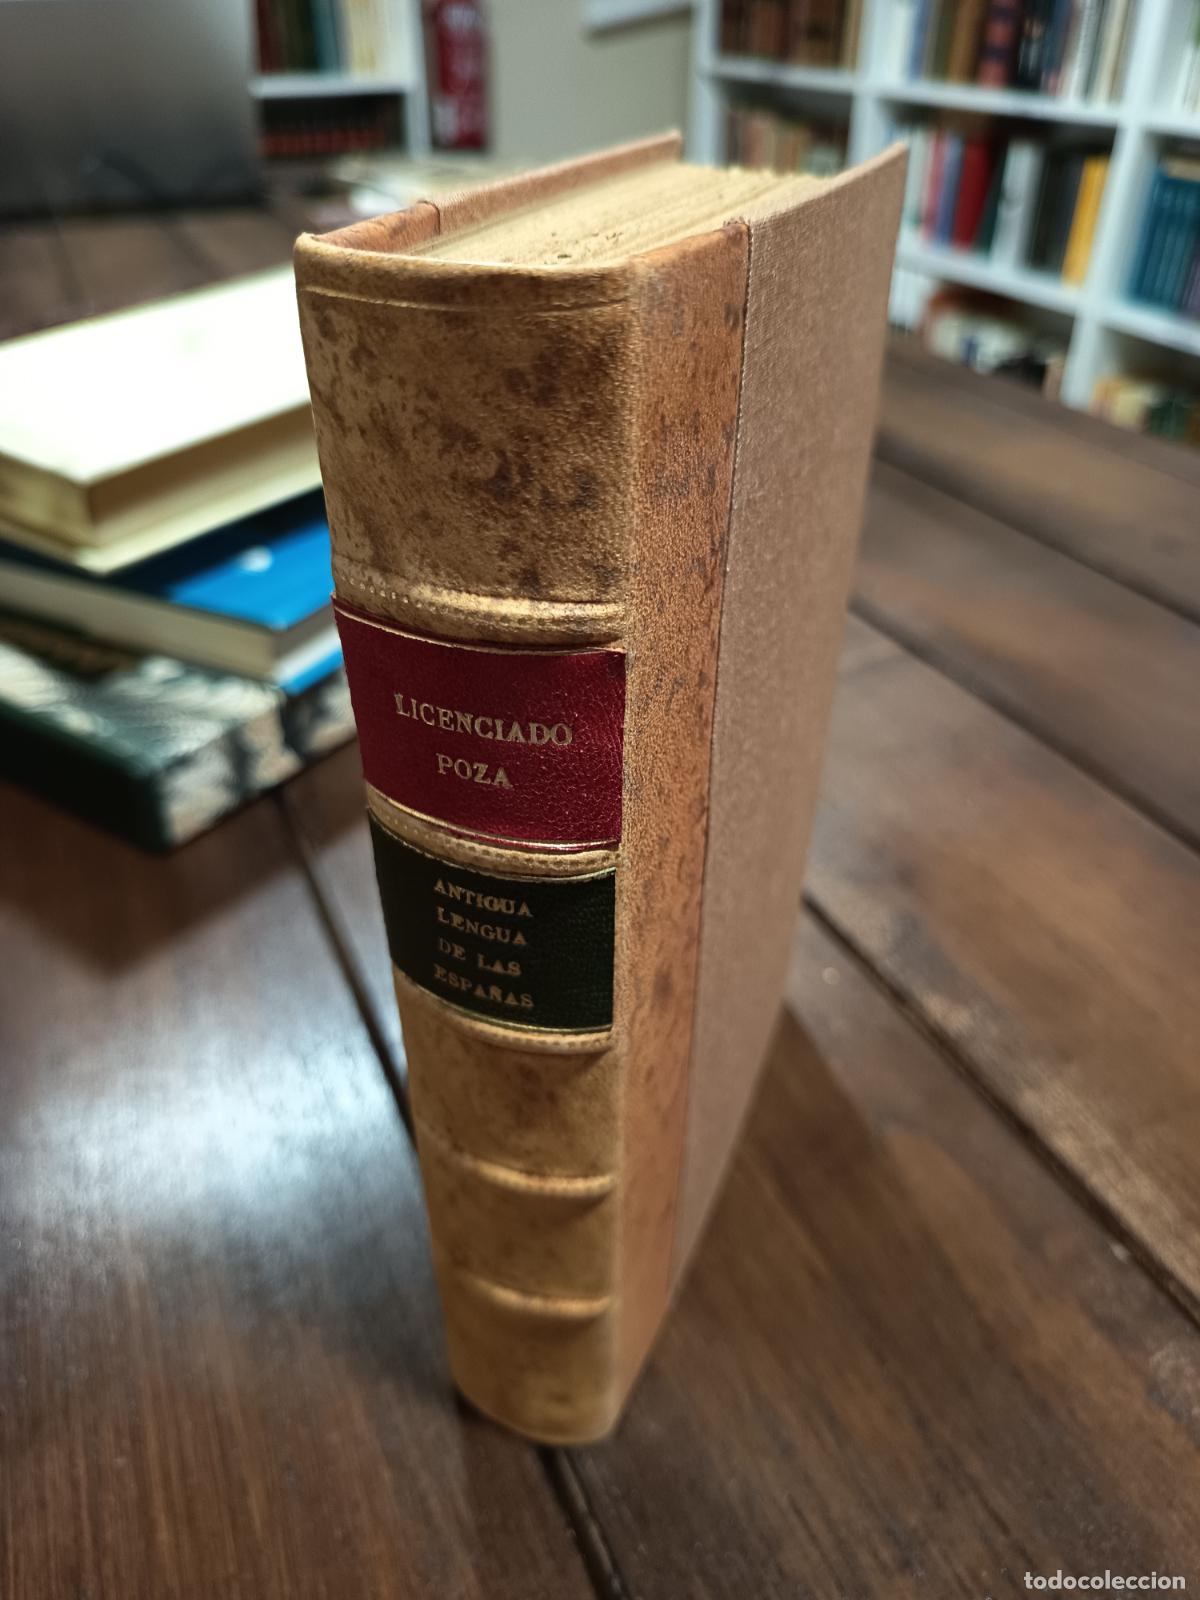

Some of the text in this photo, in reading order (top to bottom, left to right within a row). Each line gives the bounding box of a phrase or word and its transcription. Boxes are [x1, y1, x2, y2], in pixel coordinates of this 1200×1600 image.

[394, 692, 573, 746] LICENCIADO
[435, 753, 513, 789] POZA
[434, 878, 533, 917] ANTIGUA
[436, 906, 527, 945] LENGUA
[439, 938, 521, 977] DE LAS
[434, 963, 534, 1008] ESPAÑAS
